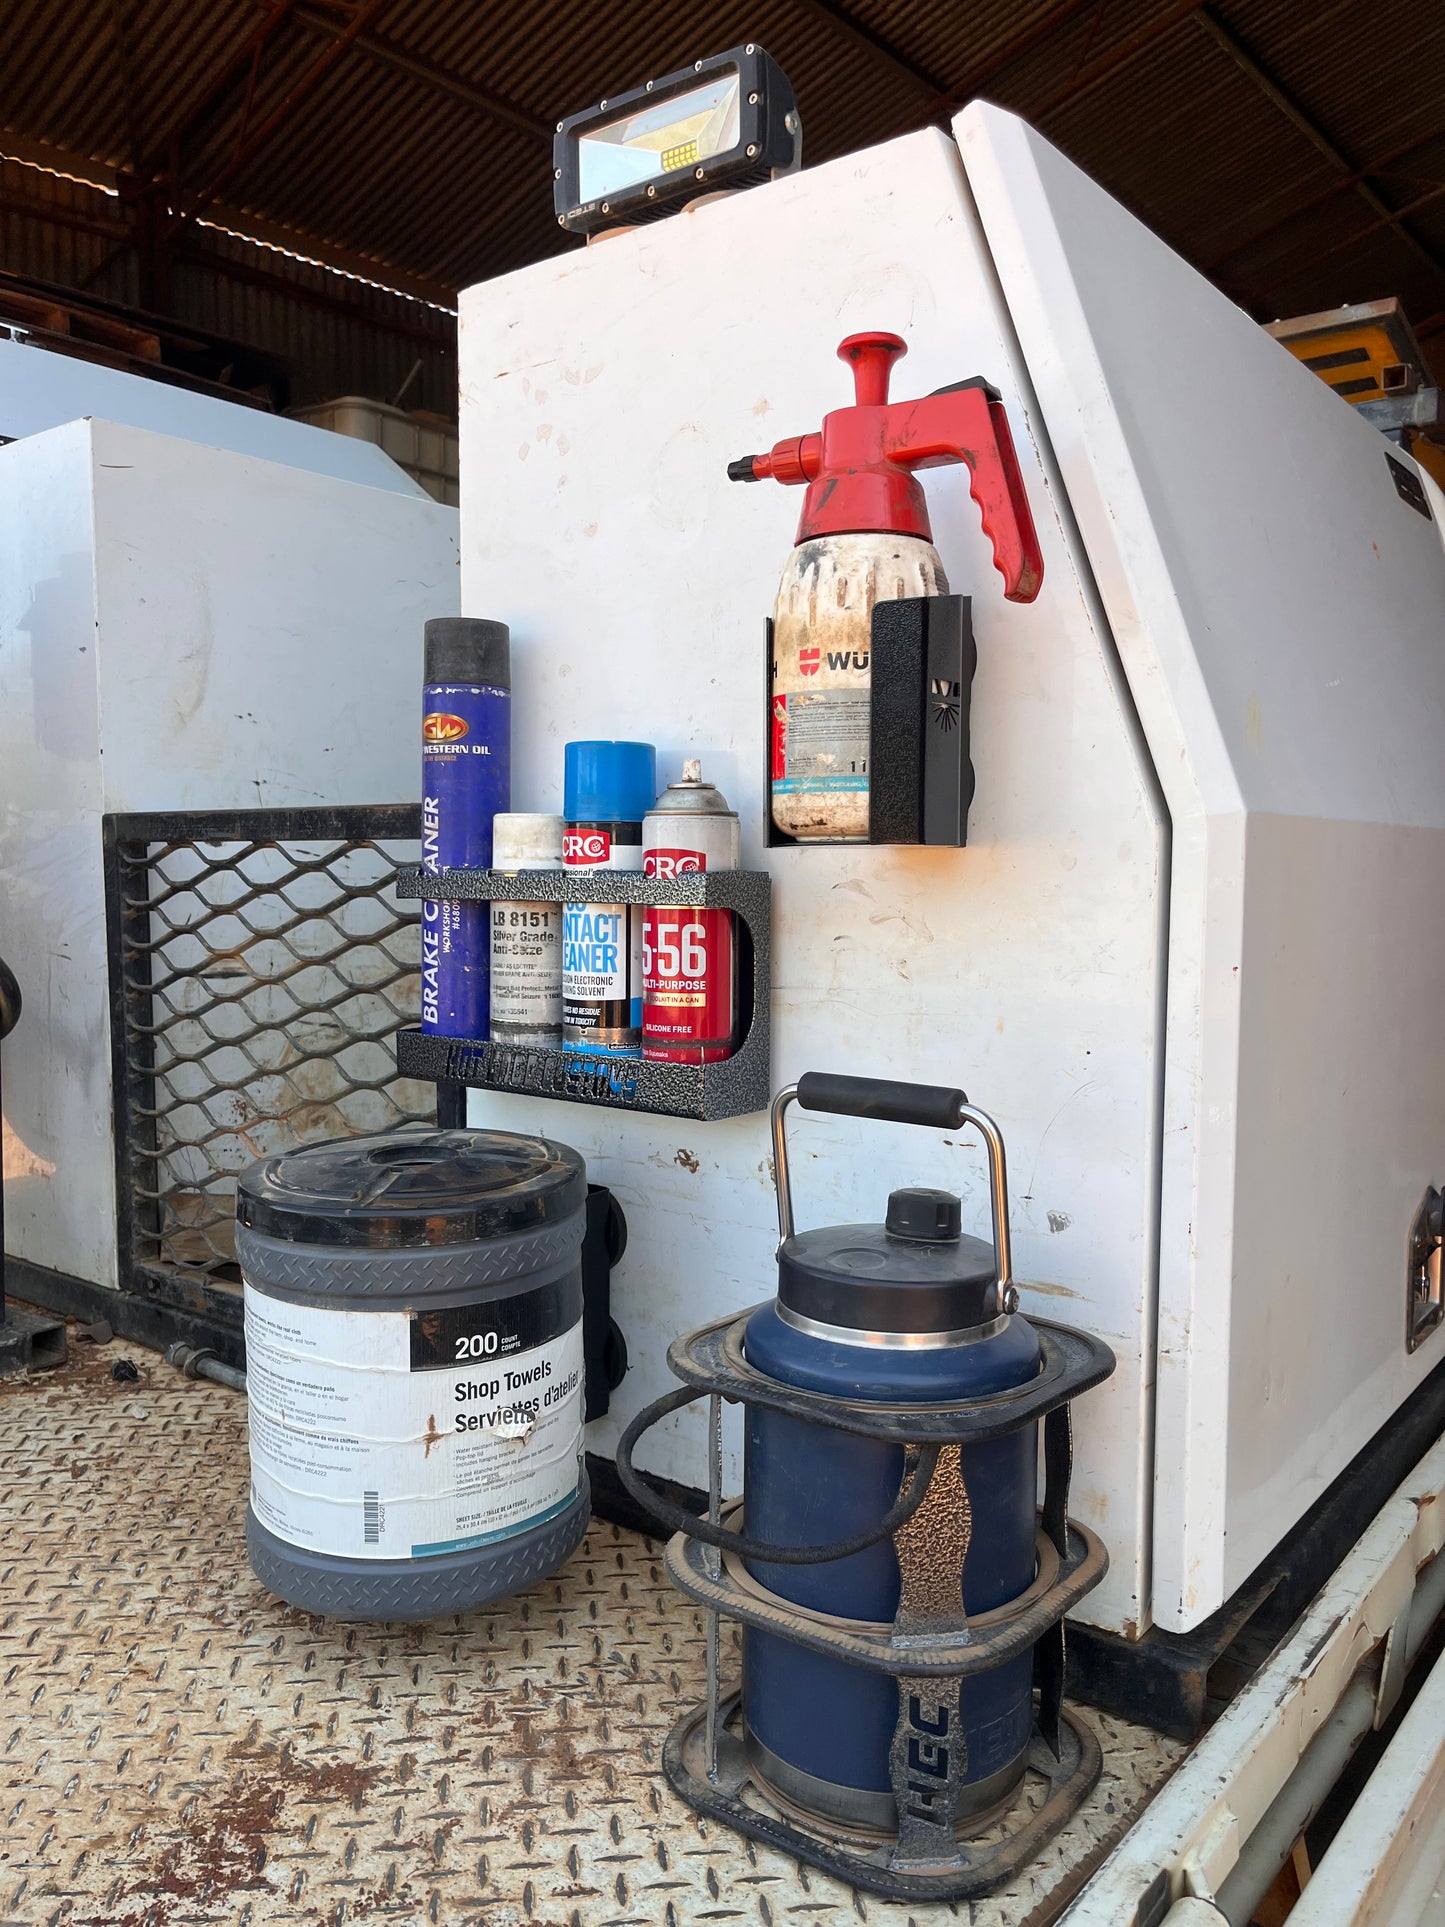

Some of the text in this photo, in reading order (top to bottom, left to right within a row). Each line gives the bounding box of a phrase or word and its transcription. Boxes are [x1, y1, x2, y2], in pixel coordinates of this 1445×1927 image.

[423, 717, 462, 739] GW
[472, 745, 491, 755] OIL
[562, 836, 605, 857] CRC
[493, 911, 506, 927] LB
[442, 899, 451, 954] WORKSHOP
[563, 913, 622, 943] NTACT
[493, 930, 554, 943] Silver Grade
[493, 943, 543, 956] Anti-Seize
[563, 943, 618, 973] EANER
[423, 928, 439, 1024] BRAKE
[574, 974, 614, 986] ELECTRONIC
[577, 985, 606, 997] SOLVENT
[643, 979, 707, 990] ULTI-PURPOSE
[578, 1007, 601, 1016] RESIDUE
[575, 1017, 596, 1026] TOXICITY
[646, 1023, 692, 1033] SILICONE FREE
[455, 1331, 498, 1360] 200
[501, 1334, 519, 1344] COUNT
[501, 1340, 521, 1352] COMPTE
[454, 1360, 552, 1402] Shop Towels
[456, 1452, 476, 1461] Pop-top
[456, 1514, 470, 1524] SHEET
[486, 1509, 500, 1517] TAILLE
[906, 1695, 950, 1828] HEC
